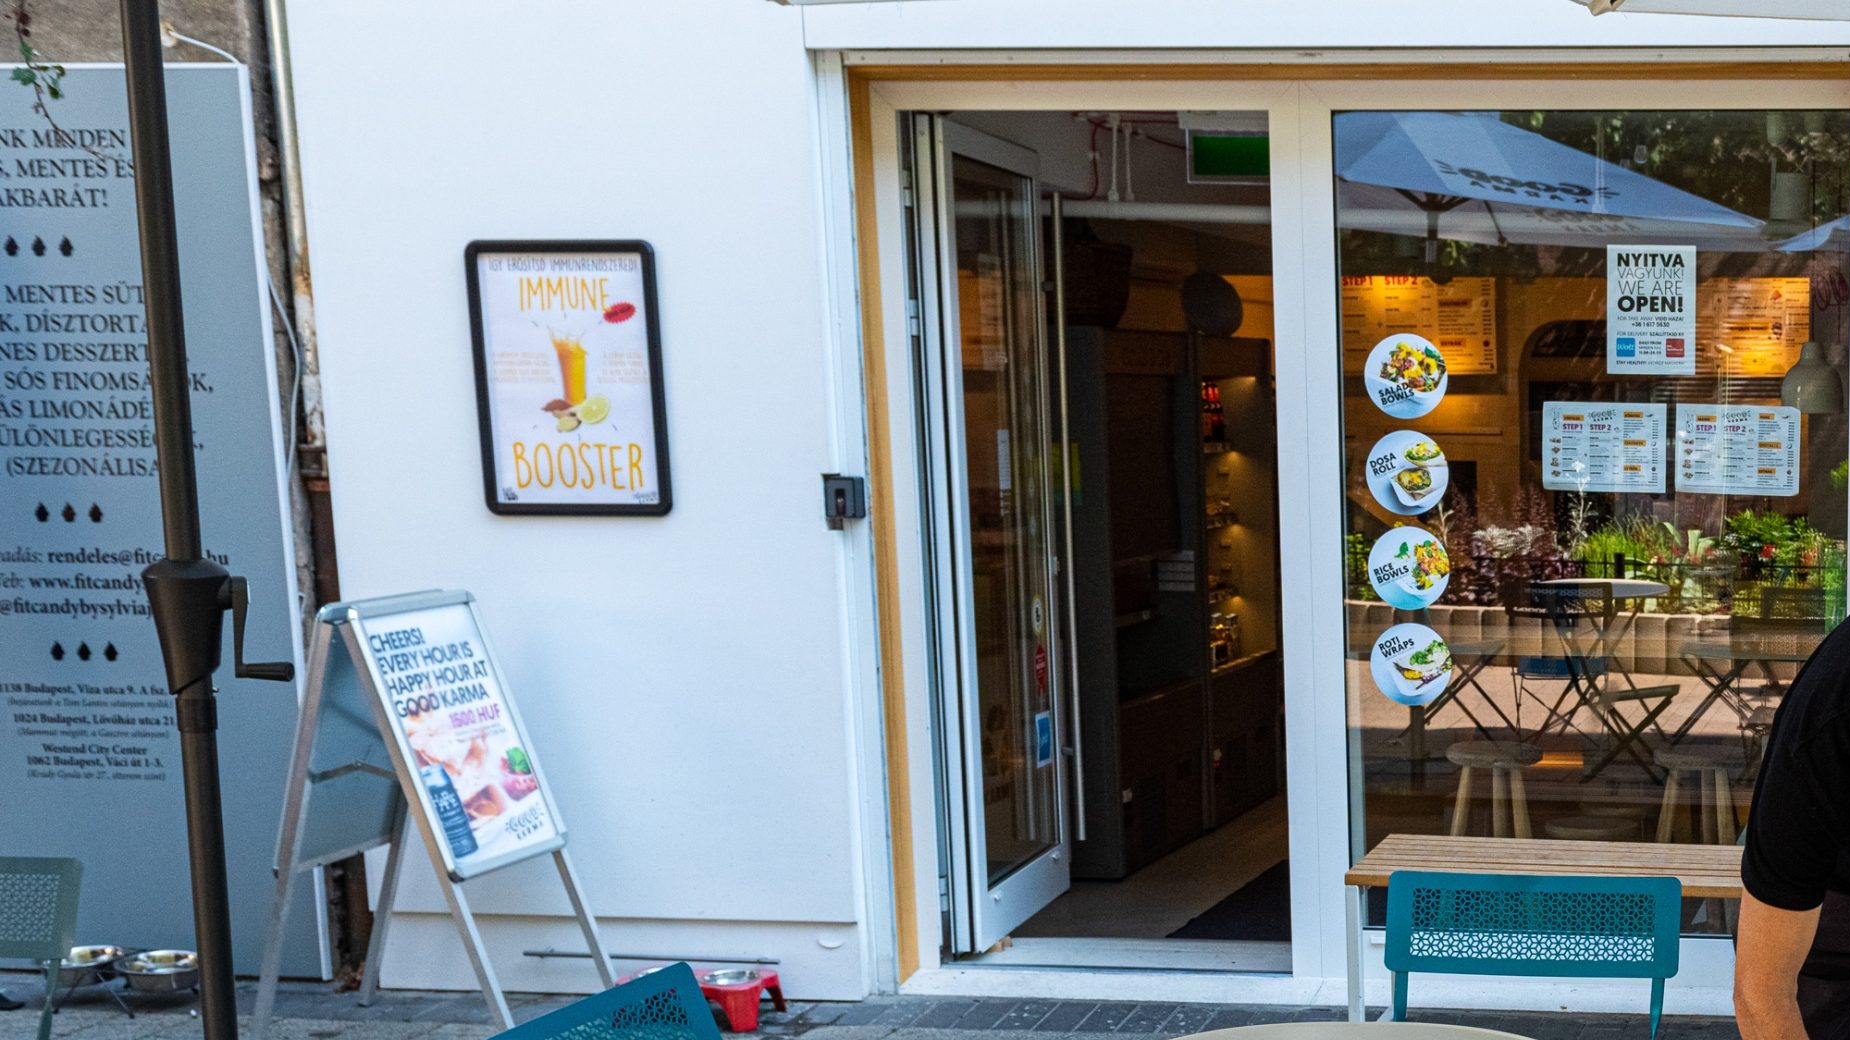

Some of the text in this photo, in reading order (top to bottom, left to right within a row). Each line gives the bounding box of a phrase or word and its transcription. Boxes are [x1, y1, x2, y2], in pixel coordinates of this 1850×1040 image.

[32, 129, 126, 149] MINDEN
[16, 158, 108, 178] MENTES
[1617, 252, 1685, 268] NYITVA
[1617, 267, 1684, 280] VAGYUNK!
[5, 284, 97, 304] MENTES
[518, 275, 610, 312] IMMUNE
[1617, 279, 1684, 296] WE ARE
[1617, 295, 1684, 313] OPEN!
[4, 366, 214, 393] SÓS FINOMSÁK,
[1378, 383, 1409, 398] SALAD
[1380, 388, 1415, 407] BOWLS
[28, 396, 152, 420] LIMONÁDÉ
[1562, 423, 1580, 431] STEP
[1696, 424, 1713, 432] STEP
[6, 453, 160, 478] (SZEZONÁLISA
[512, 441, 645, 491] BOOSTER
[1369, 452, 1397, 469] DOSA
[1372, 462, 1397, 477] ROLL
[1373, 562, 1394, 577] RICE
[1376, 565, 1410, 585] BOWLS
[29, 574, 144, 595] www.fitcandy
[368, 628, 425, 653] CHEERS!
[1378, 636, 1400, 652] ROTI
[1380, 638, 1415, 659] WRAPS
[378, 641, 474, 675] EVERY HOUR IS
[389, 660, 488, 695] HAPPY HOUR AT
[395, 682, 490, 718] GOOD KARMA
[475, 703, 501, 723] HUF
